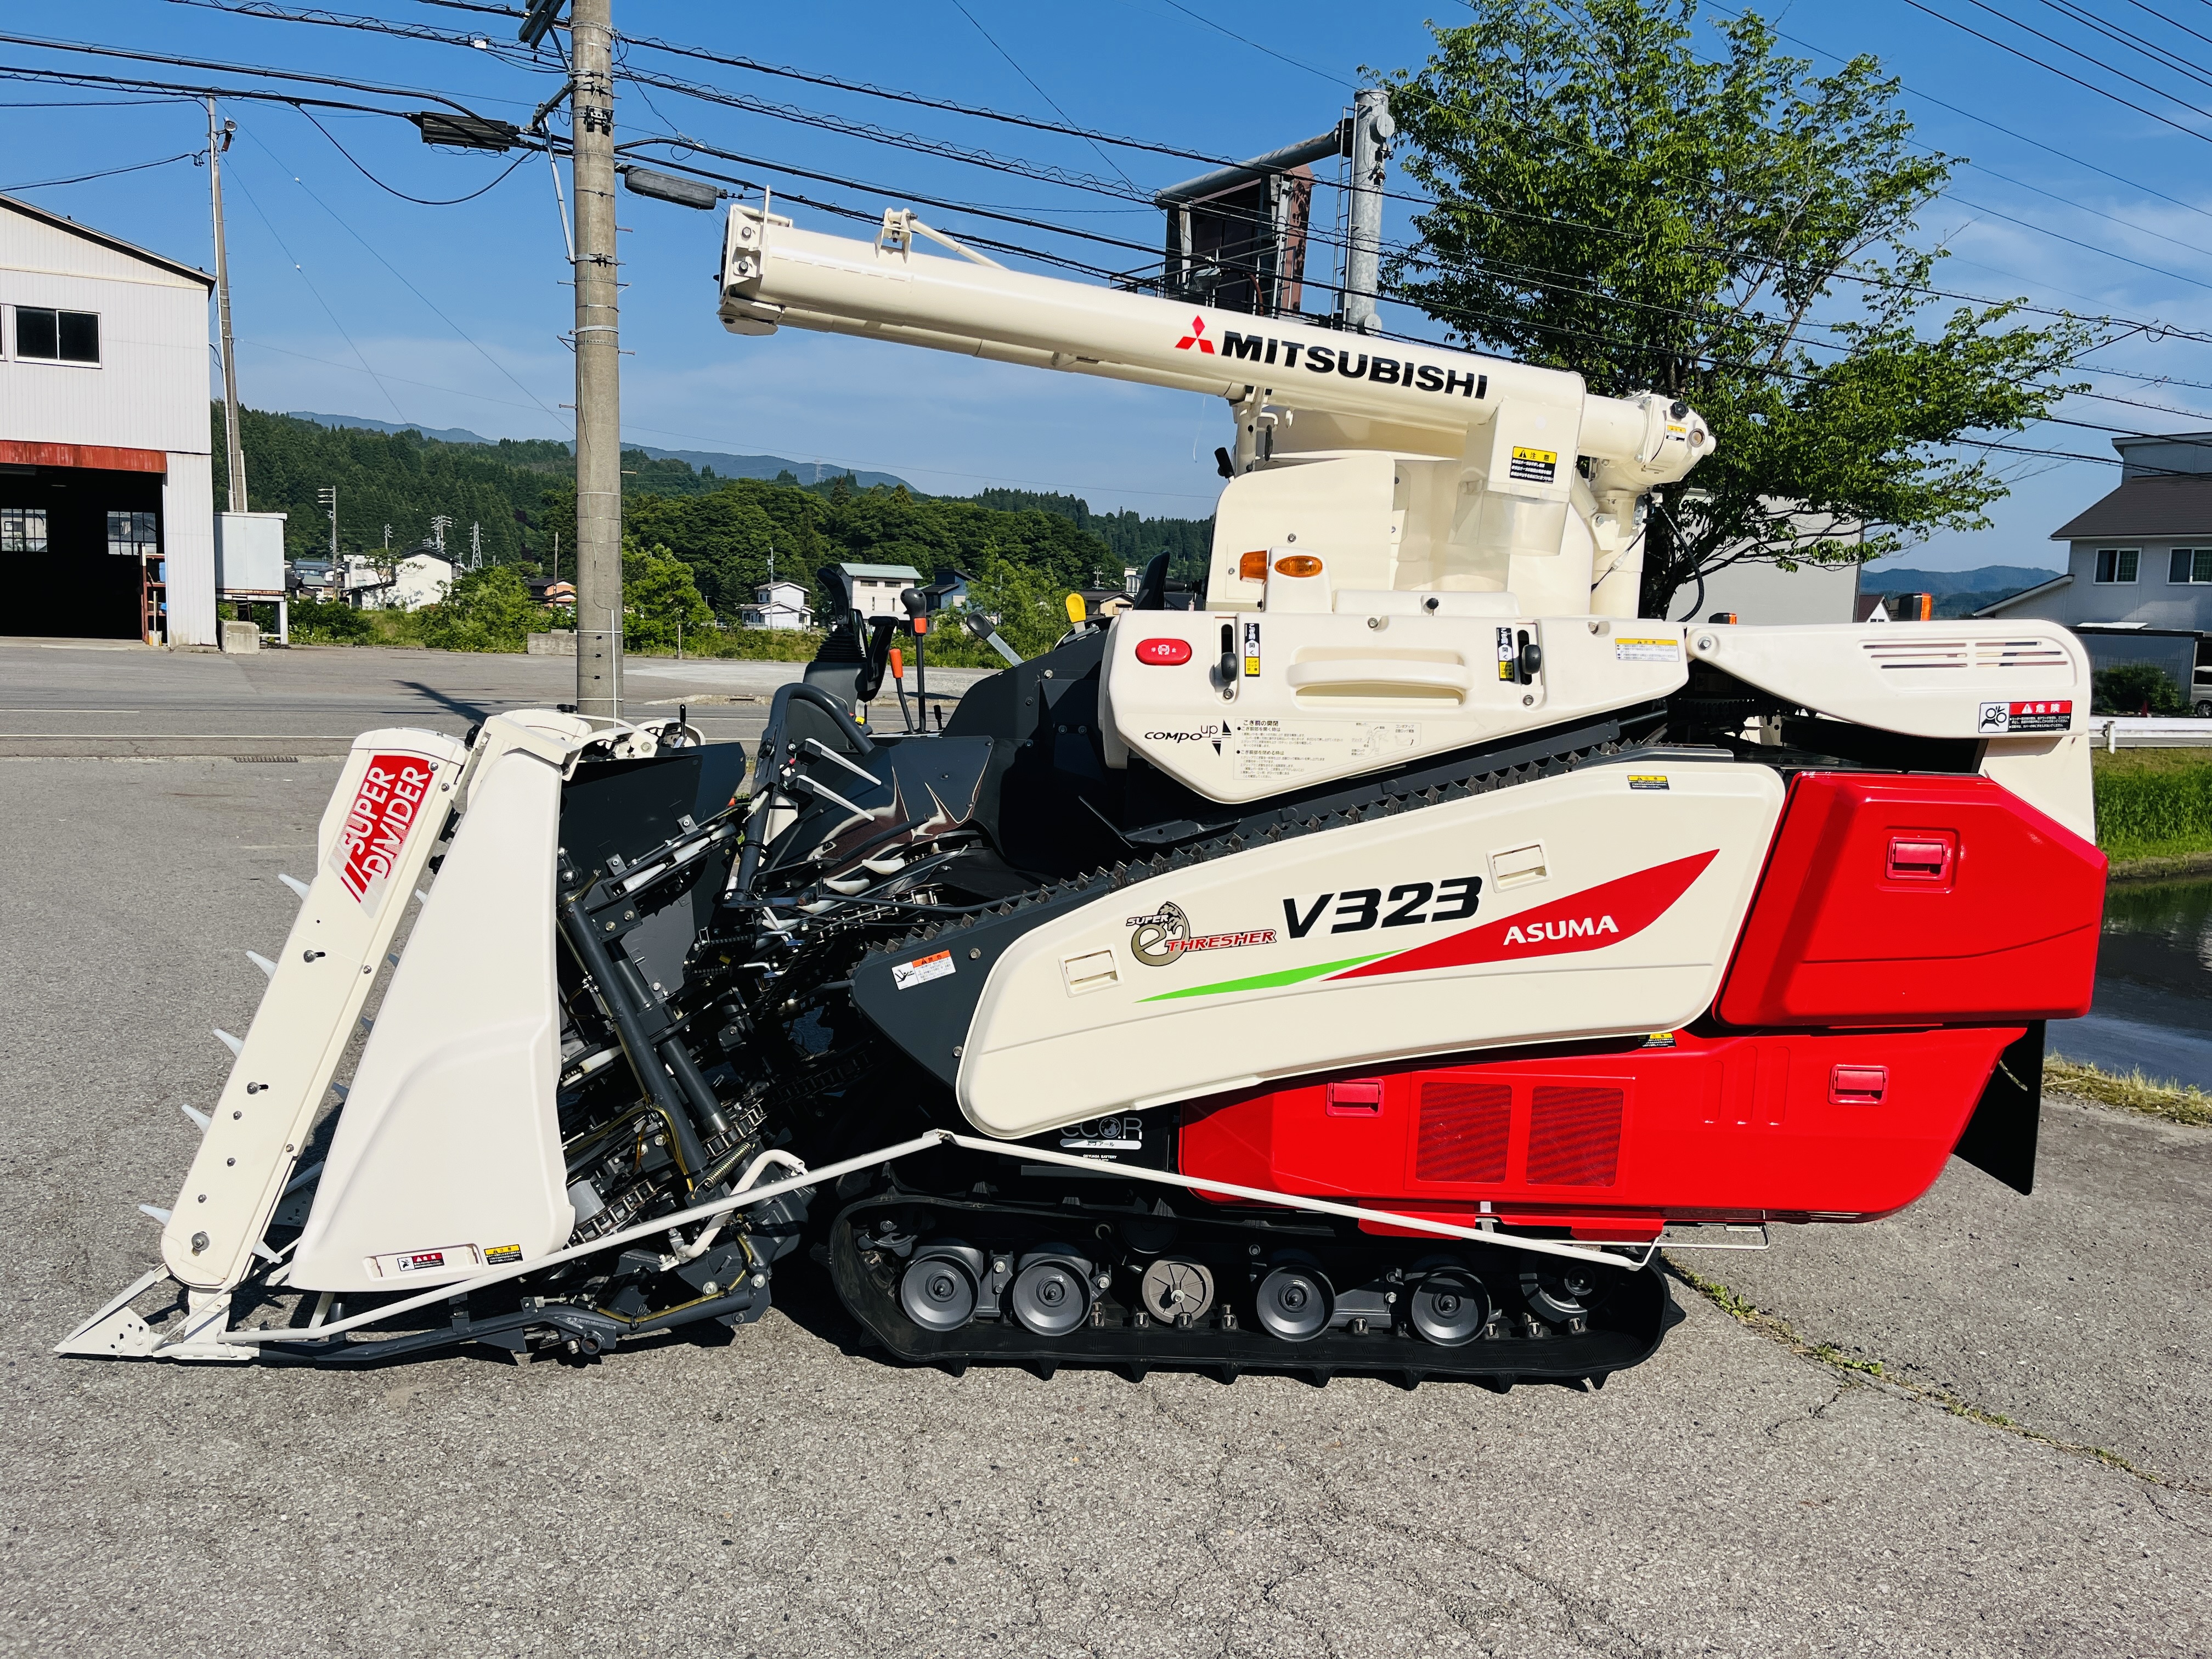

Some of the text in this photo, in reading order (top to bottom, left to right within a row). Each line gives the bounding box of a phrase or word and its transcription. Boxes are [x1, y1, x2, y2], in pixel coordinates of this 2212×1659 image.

[1221, 330, 1488, 399] MITSUBISHI
[340, 767, 396, 855] SUPER
[361, 766, 430, 879] DIVIDER
[1126, 914, 1169, 926] SUPER
[1283, 876, 1482, 939] V323
[1503, 915, 1620, 945] ASUMA
[1165, 930, 1276, 952] THRESHER
